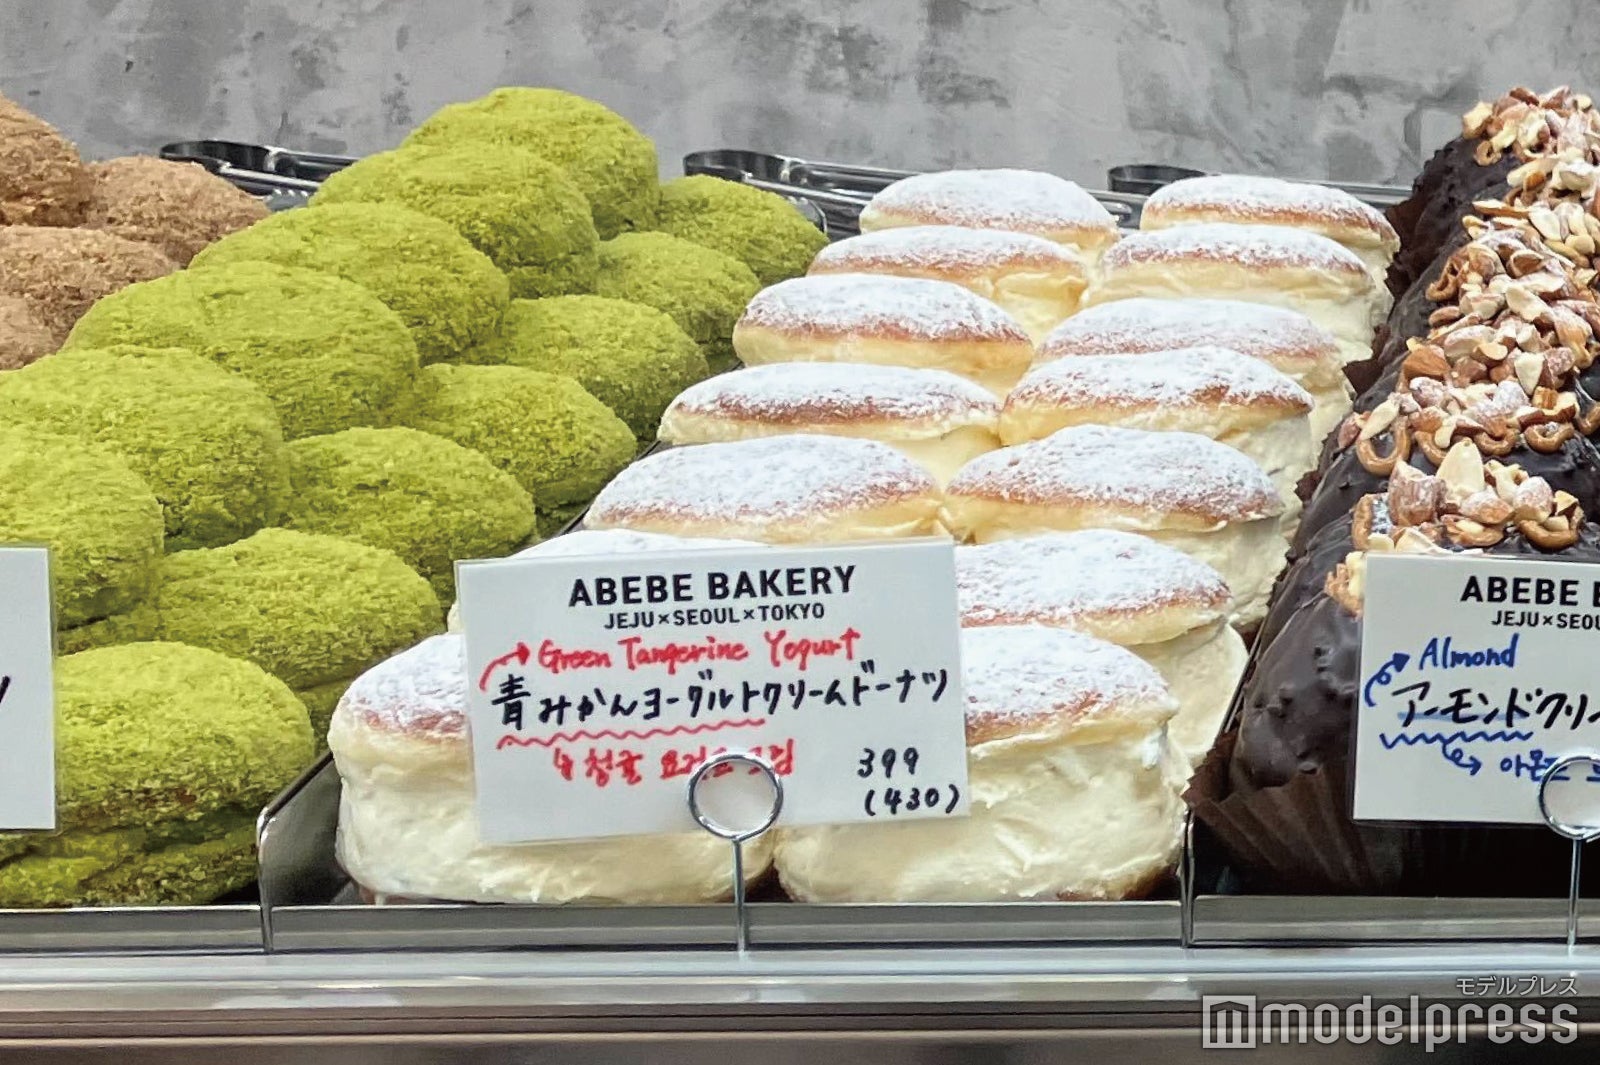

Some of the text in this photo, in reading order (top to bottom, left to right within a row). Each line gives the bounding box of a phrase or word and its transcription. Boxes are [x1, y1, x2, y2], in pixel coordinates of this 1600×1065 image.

[568, 565, 856, 607] ABEBE BAKERY
[1459, 575, 1580, 607] ABEBE
[538, 627, 861, 675] Green Tangerine Yogurt
[1419, 633, 1519, 670] Almond
[491, 659, 948, 730] 青みかんヨーグルトクリームドーナツ
[857, 747, 919, 778] 399
[864, 783, 960, 816] (430)
